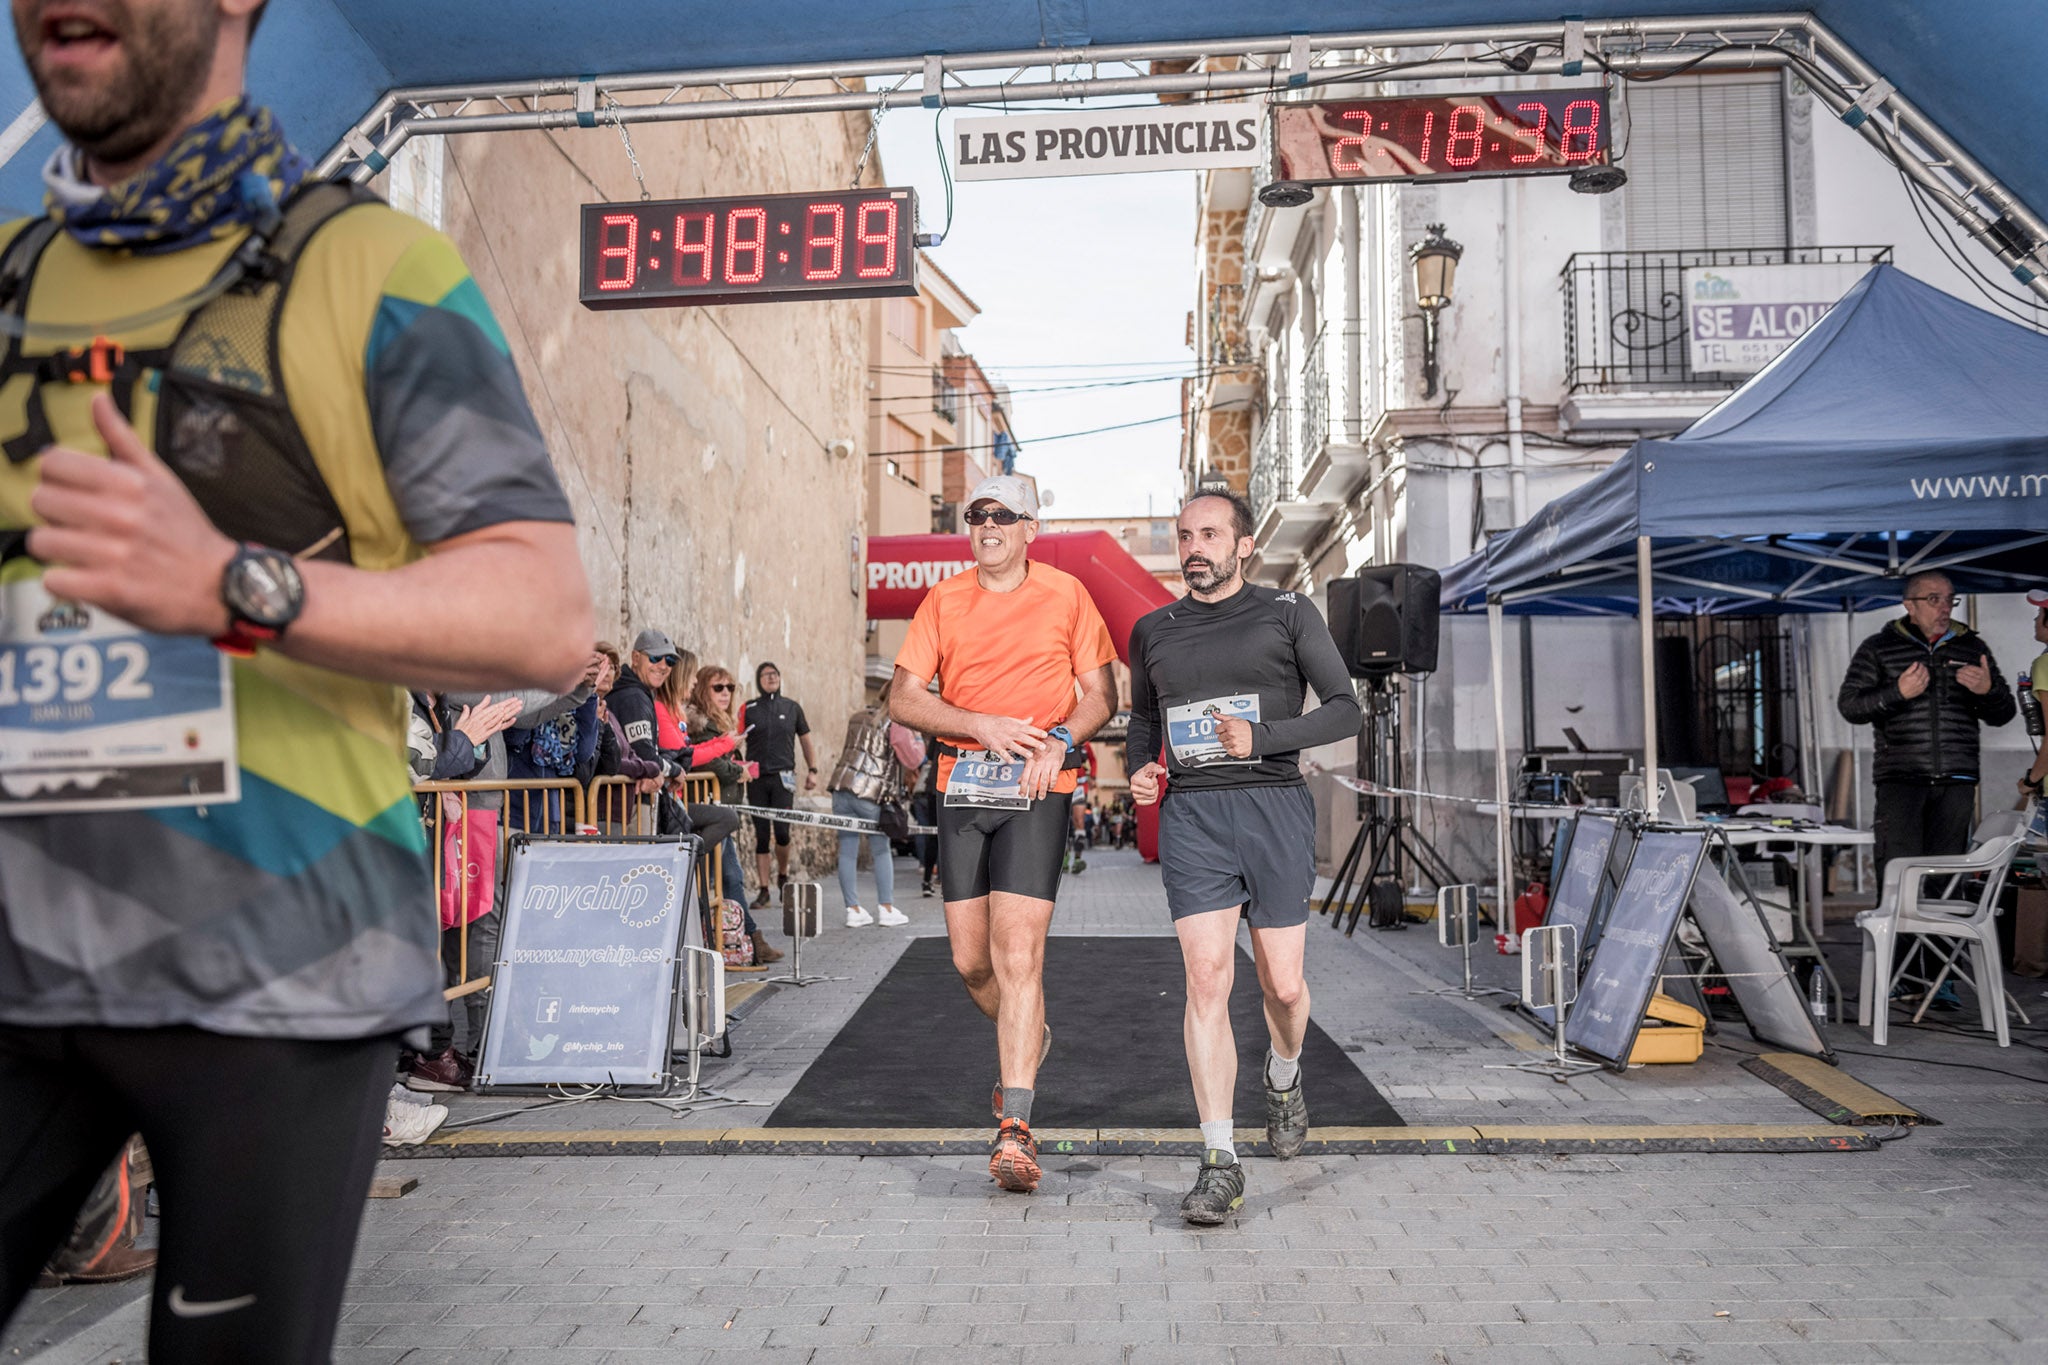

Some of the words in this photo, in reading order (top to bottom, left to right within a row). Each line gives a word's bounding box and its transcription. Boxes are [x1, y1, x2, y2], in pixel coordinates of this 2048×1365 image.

[959, 131, 1026, 165] LAS
[1035, 119, 1257, 161] PROVINCIAS
[1332, 99, 1601, 172] 2:18:38
[599, 200, 898, 290] 3:48:39
[1697, 306, 1735, 338] SE
[1701, 343, 1733, 363] TEL
[0, 641, 153, 705] 1392
[965, 763, 1013, 781] 1018
[523, 875, 648, 918] mychip
[514, 944, 662, 967] www.mychip.es
